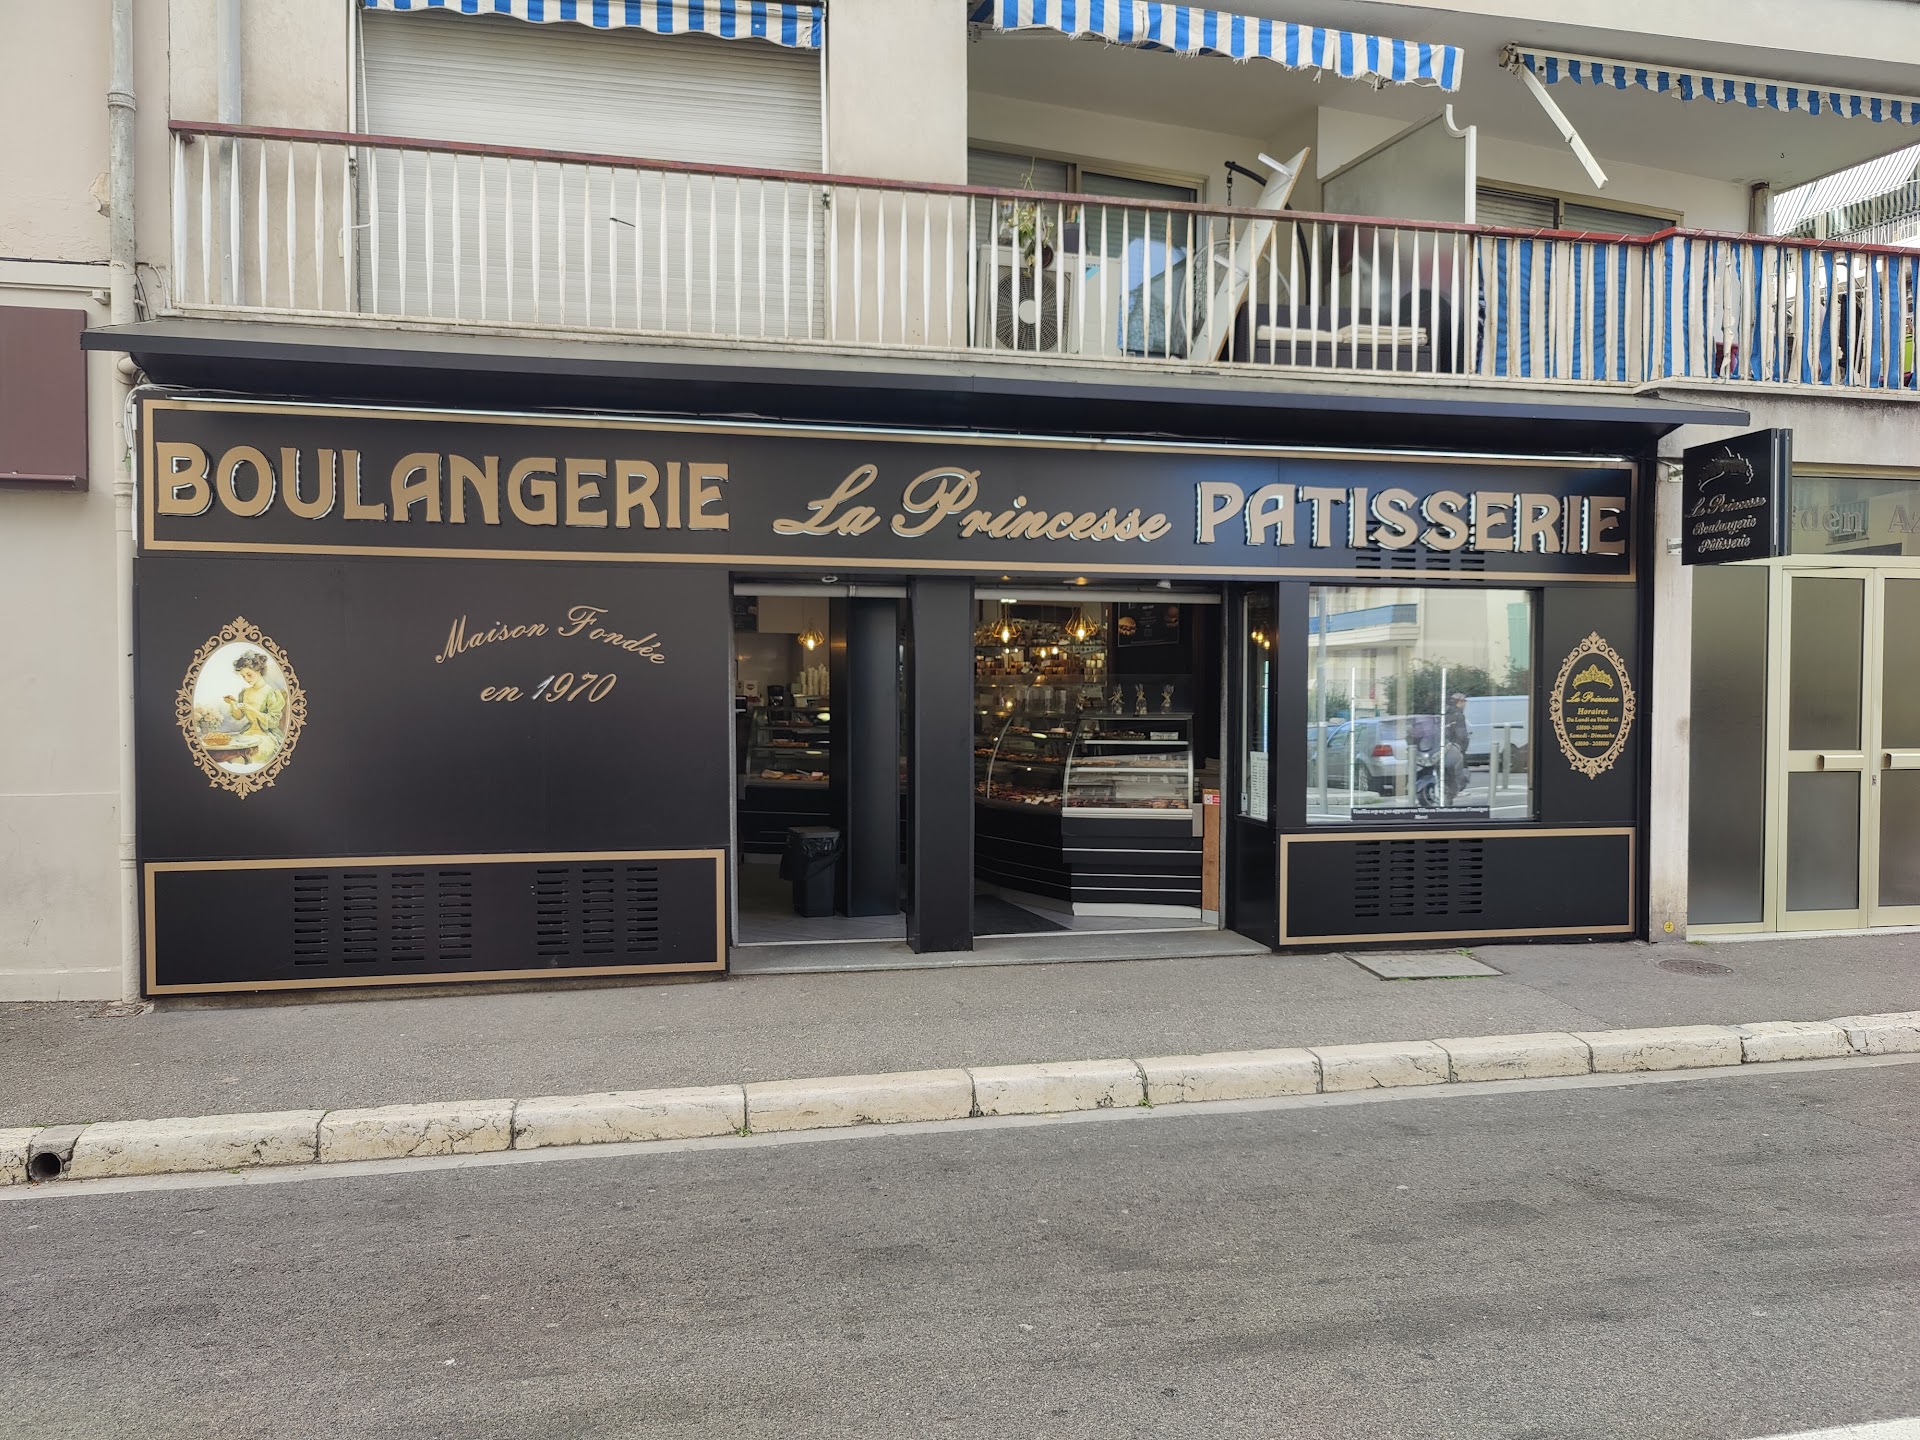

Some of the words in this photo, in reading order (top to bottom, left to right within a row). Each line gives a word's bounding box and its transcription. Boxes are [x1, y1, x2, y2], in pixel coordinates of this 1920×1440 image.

[156, 441, 729, 531] BOULANGERIE
[772, 463, 881, 536] La
[891, 466, 1172, 542] Princesse
[1707, 493, 1767, 514] Princesse
[1195, 481, 1626, 555] PATISSERIE
[1692, 514, 1757, 535] Boulangerie
[435, 615, 549, 664] Maison
[558, 605, 665, 664] Fondée
[480, 676, 524, 702] en
[531, 672, 617, 703] 1970
[1577, 707, 1608, 715] Horaires
